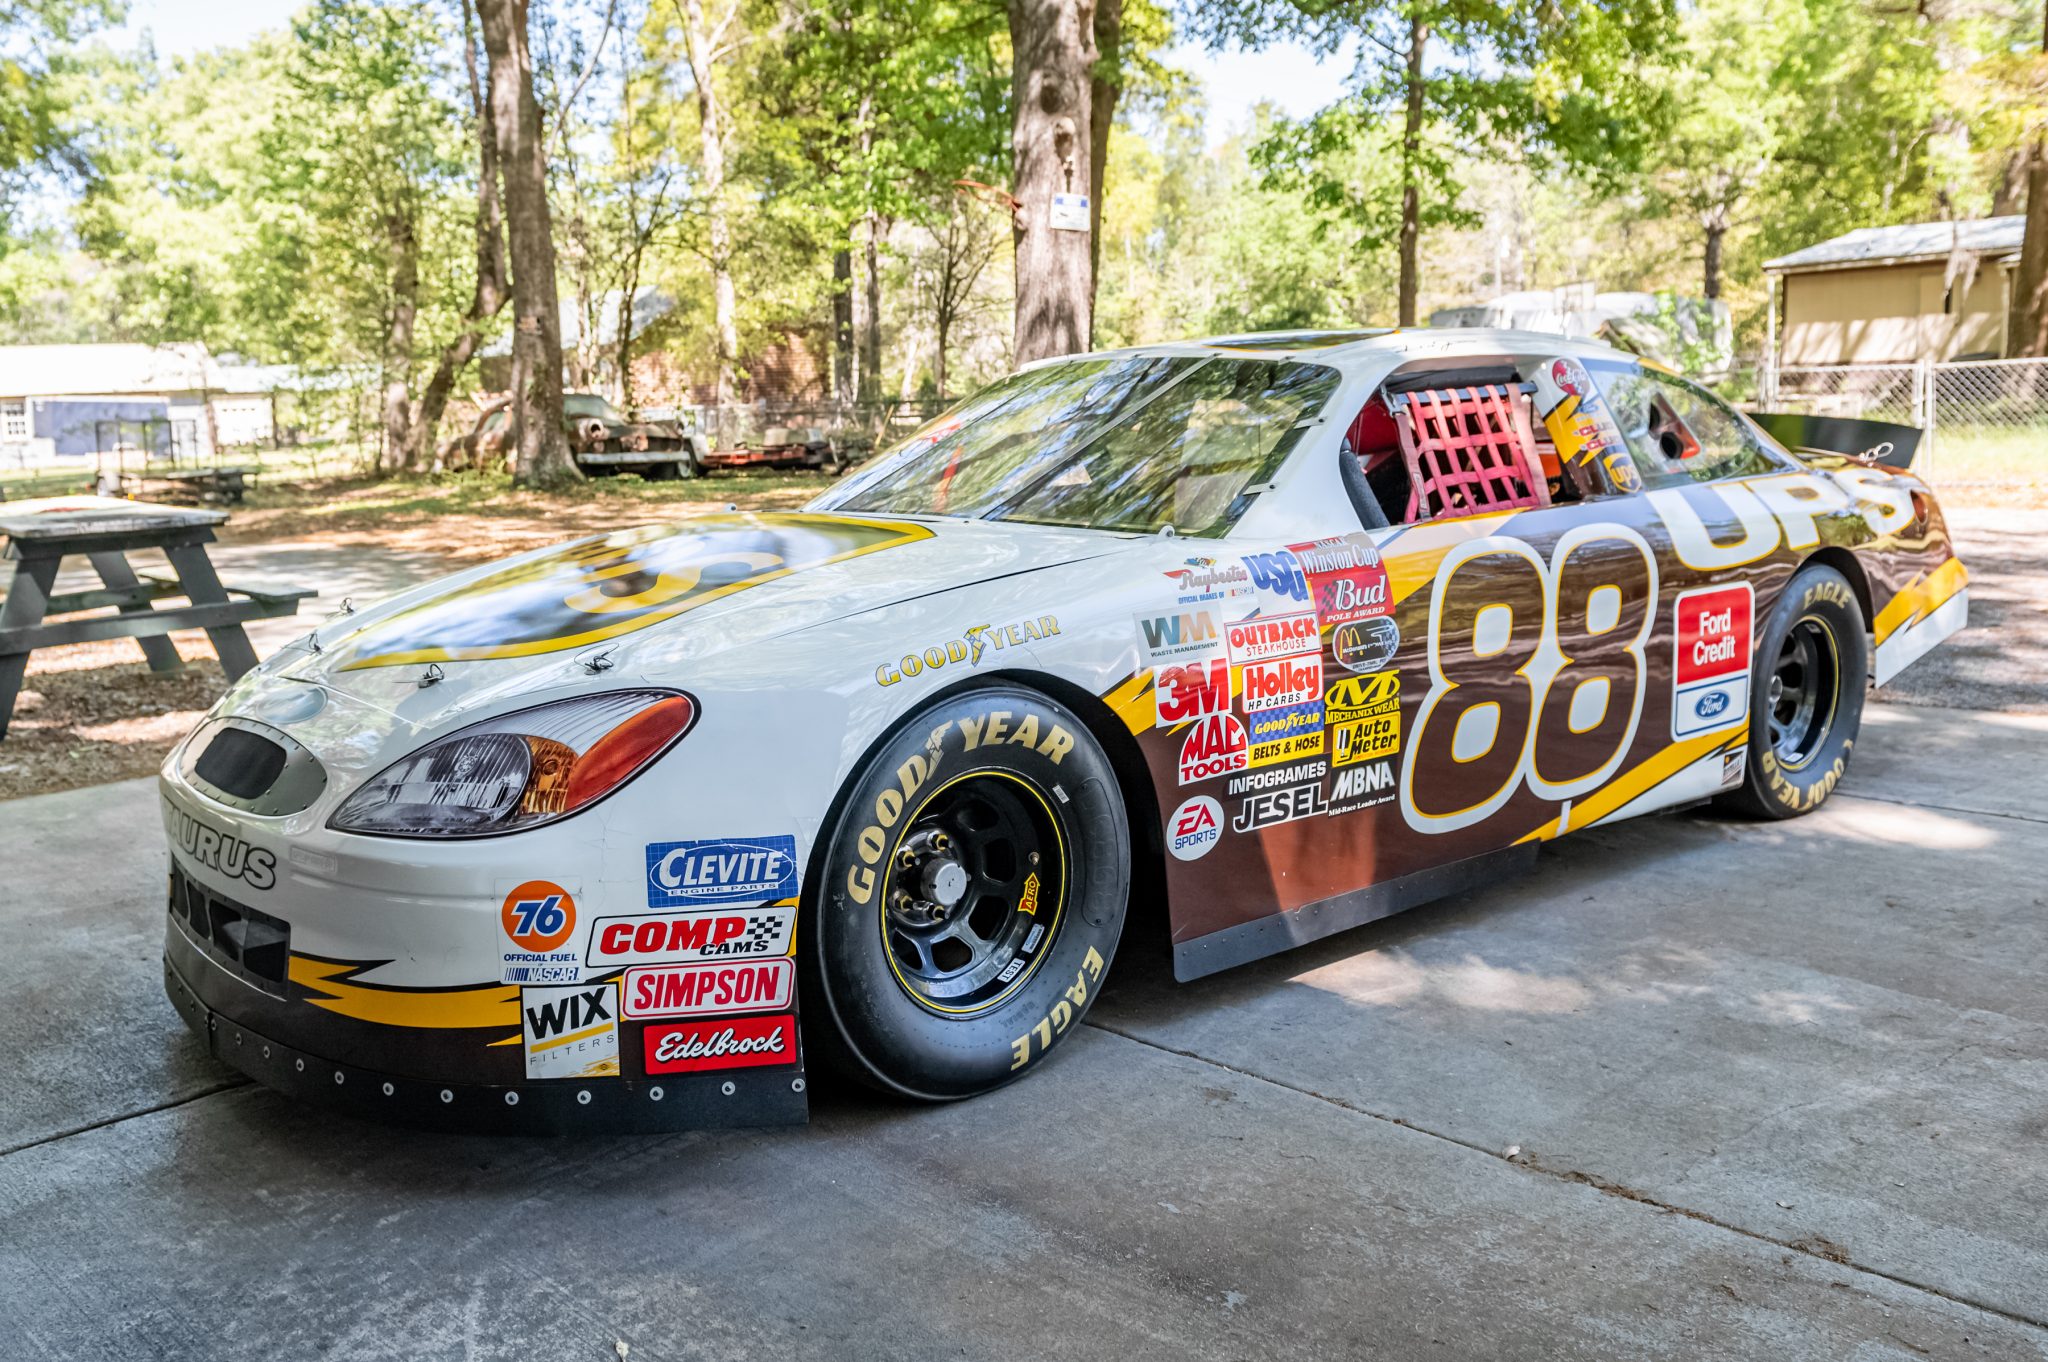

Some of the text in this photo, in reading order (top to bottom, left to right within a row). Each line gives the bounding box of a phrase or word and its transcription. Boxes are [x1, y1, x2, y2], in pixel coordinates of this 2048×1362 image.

[1646, 467, 1916, 572] UPS
[1300, 544, 1379, 575] Winston Cup
[1240, 551, 1309, 602] USG
[1335, 575, 1386, 611] Bud
[1803, 580, 1852, 609] EAGLE
[1141, 611, 1217, 648] WM
[1326, 606, 1385, 622] POLE AWARD
[1699, 607, 1731, 637] Ford
[1230, 618, 1317, 649] OUTBACK
[1246, 638, 1306, 657] STEAKHOUSE
[1150, 641, 1219, 658] WASTE MANAGEMENT
[1693, 635, 1736, 666] Credit
[1158, 658, 1229, 721] 3M
[1246, 661, 1320, 701] Holley
[1400, 523, 1660, 834] 88
[1248, 692, 1301, 711] HP CARBS
[1325, 697, 1400, 724] MECHANIX WEAR
[1700, 693, 1724, 716] Ford
[1181, 715, 1248, 765] MAC
[1352, 733, 1397, 755] Meter
[1354, 719, 1391, 740] Auto
[1253, 735, 1321, 760] BELTS & HOSE
[1181, 753, 1247, 782] TOOLS
[1228, 761, 1327, 795] INFOGRAMES
[1330, 761, 1395, 802] MBNA
[1176, 803, 1216, 837] EA
[1233, 782, 1328, 833] JESEL
[1328, 793, 1396, 817] Mid-Race Leader Award
[1174, 828, 1217, 850] SPORTS
[658, 848, 784, 888] CLEVITE
[671, 883, 777, 895] ENGINE PARTS
[1025, 880, 1037, 909] AERO
[510, 895, 567, 937] 76
[600, 916, 746, 955] COMP
[699, 940, 769, 956] CAMS
[503, 954, 548, 962] OFFICIAL
[1001, 961, 1021, 980] TEST
[526, 967, 579, 981] NASCAR
[633, 966, 781, 1010] SIMPSON
[526, 986, 612, 1041] WIX
[1010, 945, 1104, 1071] EAGLE
[530, 1034, 615, 1066] FILTERS
[655, 1026, 785, 1062] Edelbrock
